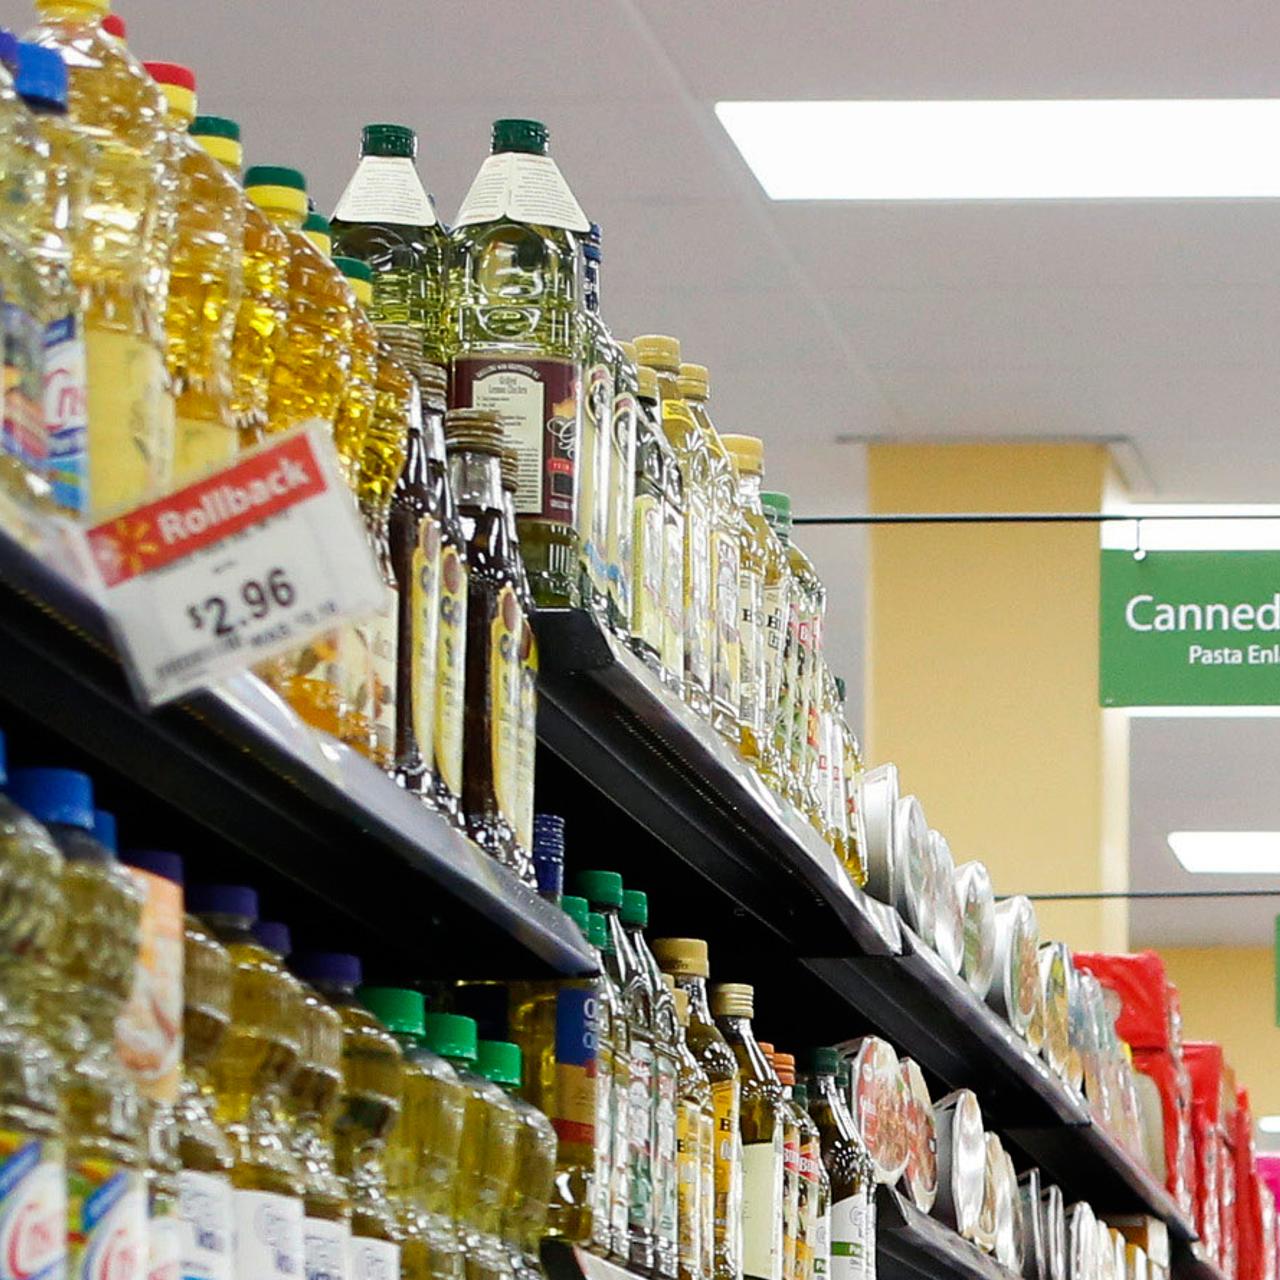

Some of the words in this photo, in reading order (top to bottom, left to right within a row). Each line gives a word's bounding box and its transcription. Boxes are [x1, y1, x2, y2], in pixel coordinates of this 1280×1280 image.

[158, 458, 309, 544] Rollback
[187, 568, 295, 636] $2.96
[1126, 593, 1280, 632] Canned
[1188, 645, 1242, 664] Pasta
